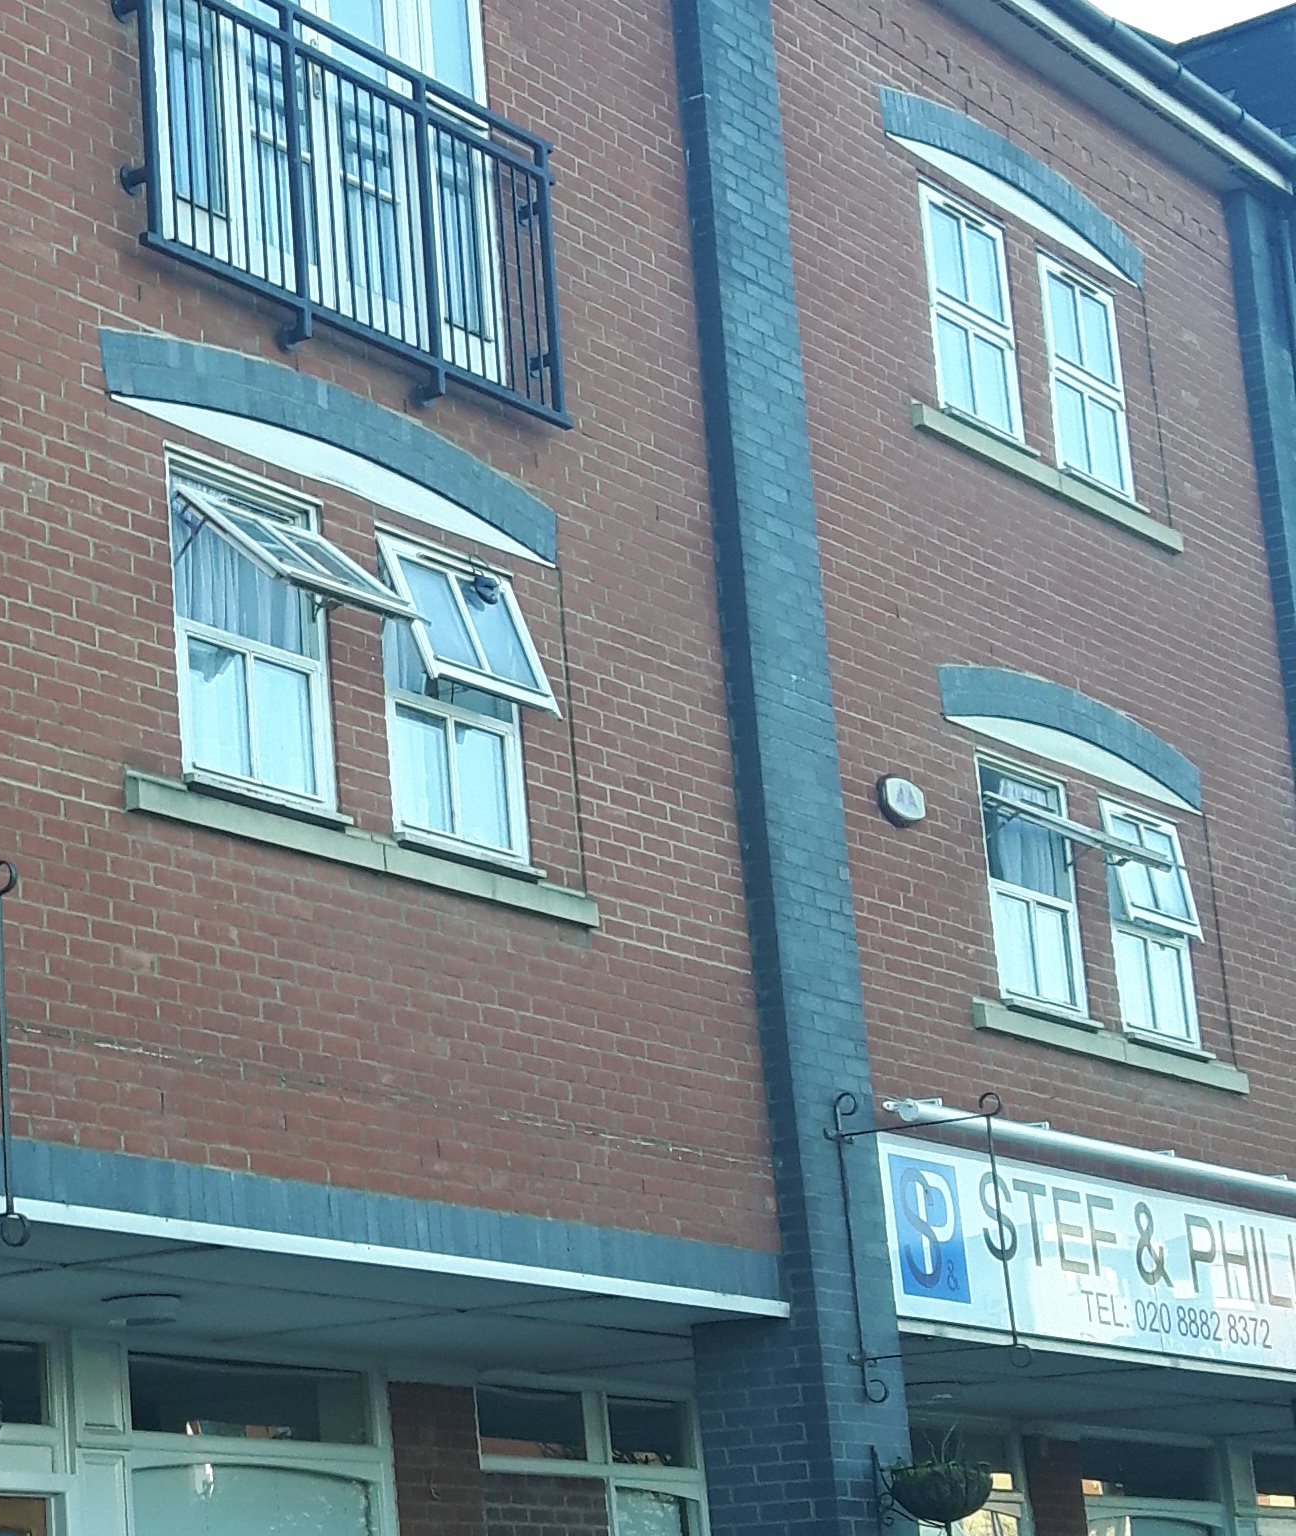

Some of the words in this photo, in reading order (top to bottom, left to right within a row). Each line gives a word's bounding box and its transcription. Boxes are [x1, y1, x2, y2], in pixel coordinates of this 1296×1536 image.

[979, 1171, 1117, 1277] STEF
[1134, 1201, 1174, 1288] &
[1184, 1213, 1296, 1309] PHIL
[1081, 1290, 1130, 1328] TEL:
[1135, 1299, 1172, 1334] 020
[1177, 1305, 1224, 1342] 8882
[1227, 1313, 1272, 1349] 8372
